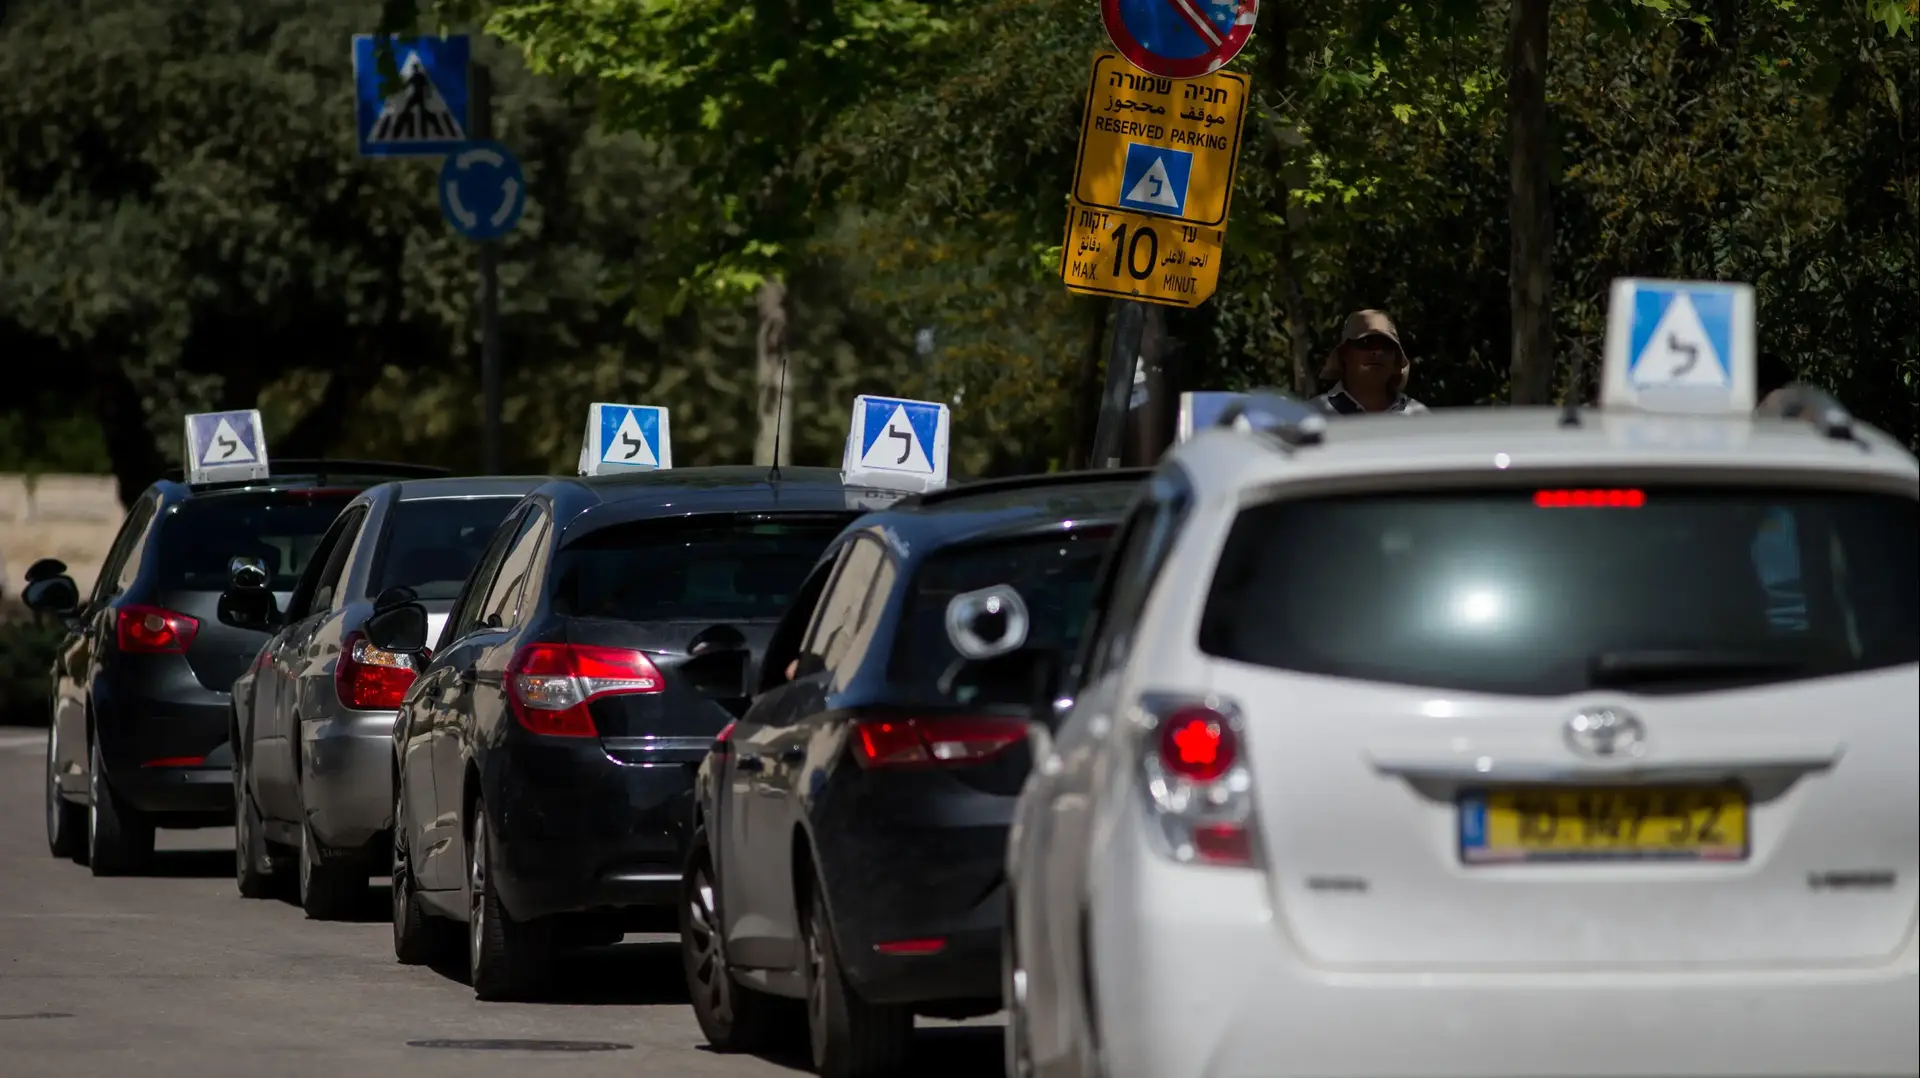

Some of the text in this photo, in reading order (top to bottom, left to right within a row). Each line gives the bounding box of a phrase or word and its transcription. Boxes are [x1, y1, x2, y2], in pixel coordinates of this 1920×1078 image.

[1109, 71, 1228, 105] חניה שמורה
[1104, 95, 1225, 128] موقف محجوز
[1095, 116, 1228, 151] RESERVED PARKING
[1077, 234, 1101, 256] دقائق
[1079, 210, 1198, 280] עד 10 דקות
[1162, 275, 1198, 295] MINUT.
[1666, 332, 1699, 378] ל
[217, 434, 237, 459] ל
[622, 431, 641, 460] ל
[888, 423, 912, 465] ל
